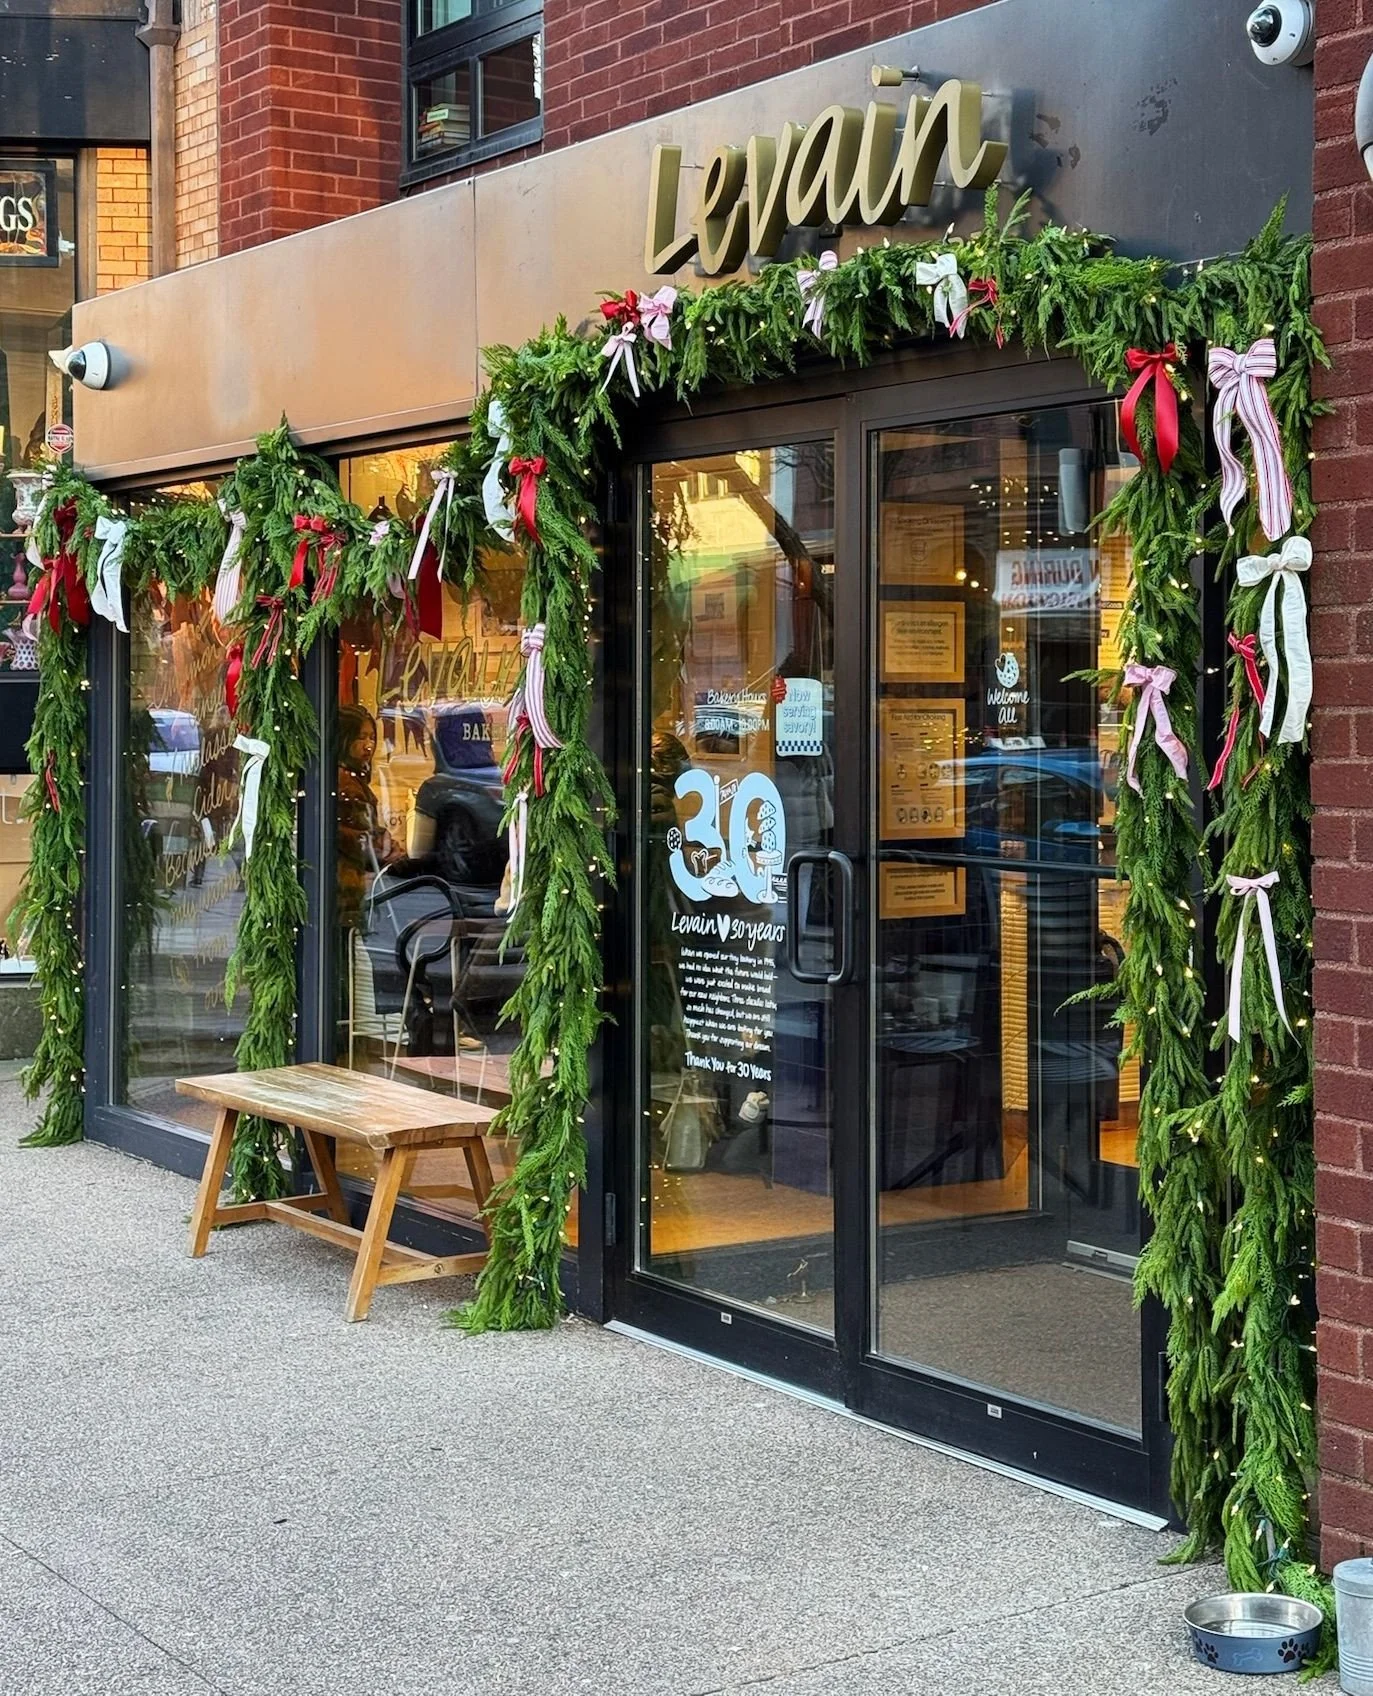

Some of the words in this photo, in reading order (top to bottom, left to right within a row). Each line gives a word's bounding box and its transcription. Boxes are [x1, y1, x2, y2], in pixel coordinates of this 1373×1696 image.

[644, 64, 1008, 275] Levain
[707, 688, 740, 705] Bakery
[741, 688, 767, 704] Hours
[788, 688, 811, 703] Now
[987, 688, 1030, 705] Welcome
[783, 705, 817, 720] serving
[783, 721, 817, 736] savory!
[669, 768, 786, 904] 30
[671, 911, 718, 935] Levain
[730, 918, 745, 940] 30
[745, 922, 786, 952] years
[685, 1050, 711, 1071] Thank
[711, 1056, 725, 1072] You
[726, 1060, 737, 1074] for
[737, 1062, 750, 1078] 30
[750, 1064, 772, 1081] Years
